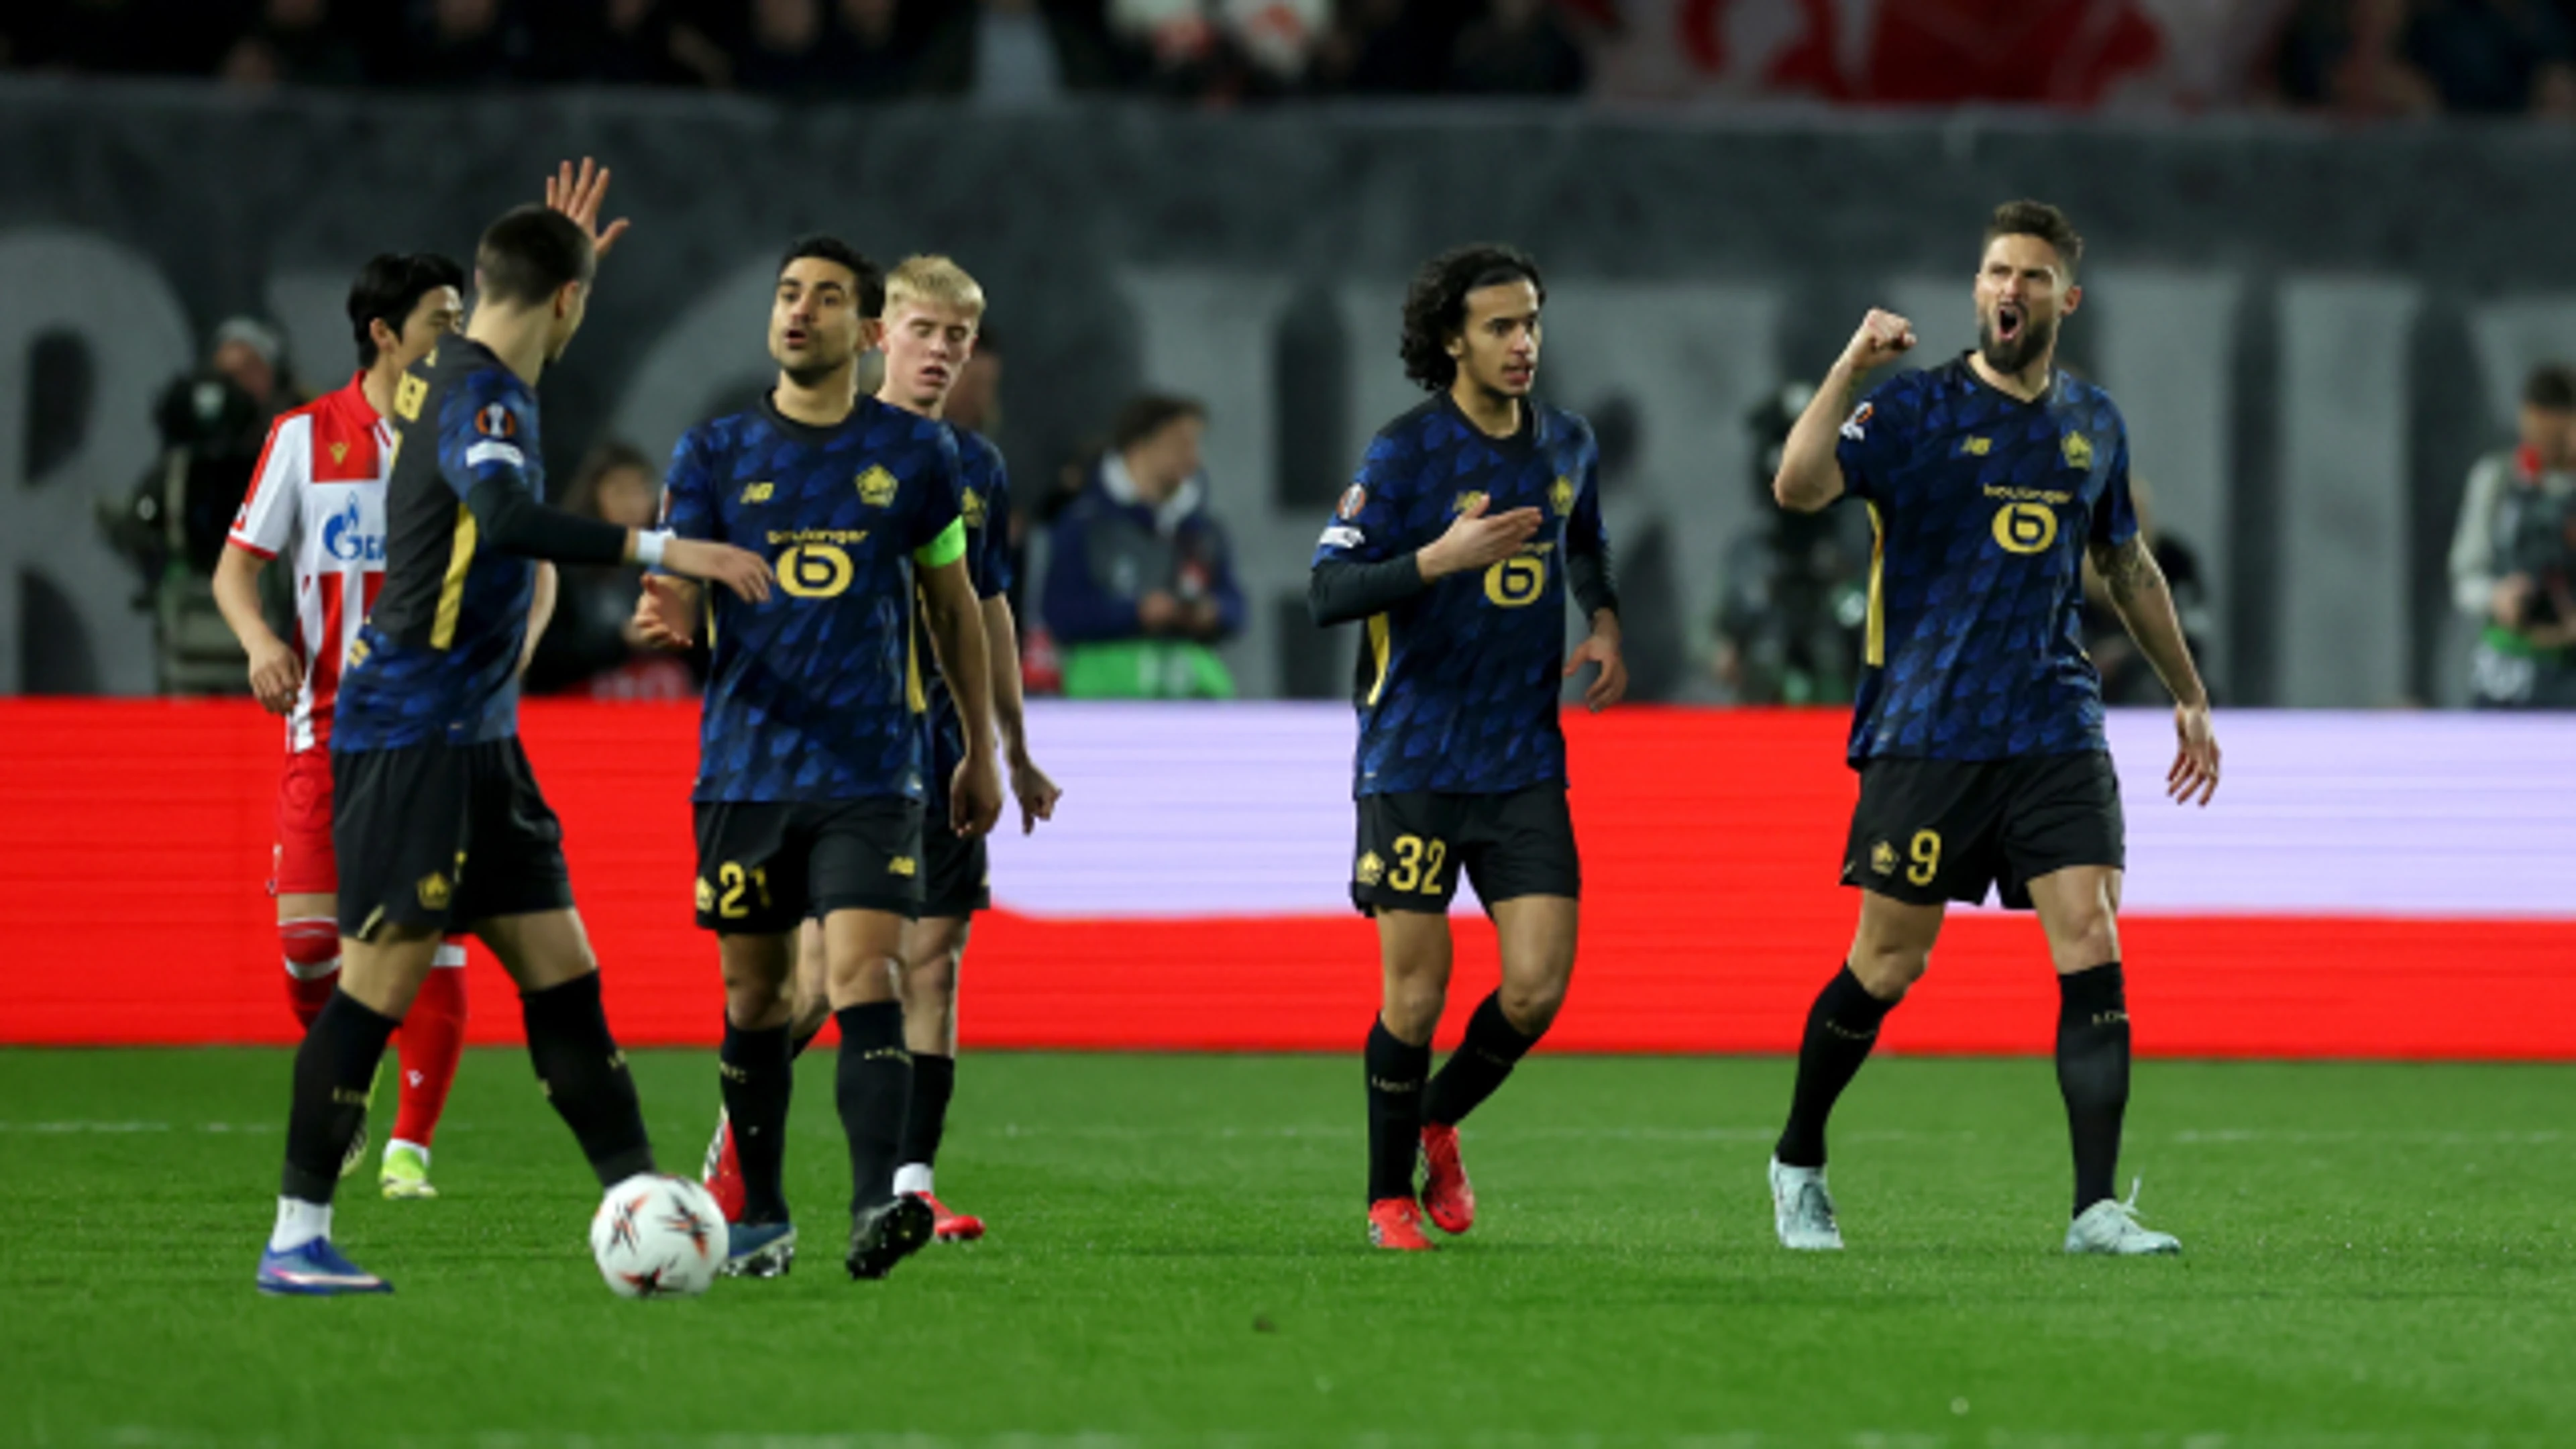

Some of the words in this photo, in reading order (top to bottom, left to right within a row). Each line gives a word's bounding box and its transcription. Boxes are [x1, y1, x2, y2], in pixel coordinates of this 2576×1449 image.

[1387, 834, 1446, 894] 32
[1907, 828, 1941, 885] 9
[719, 861, 771, 918] 21
